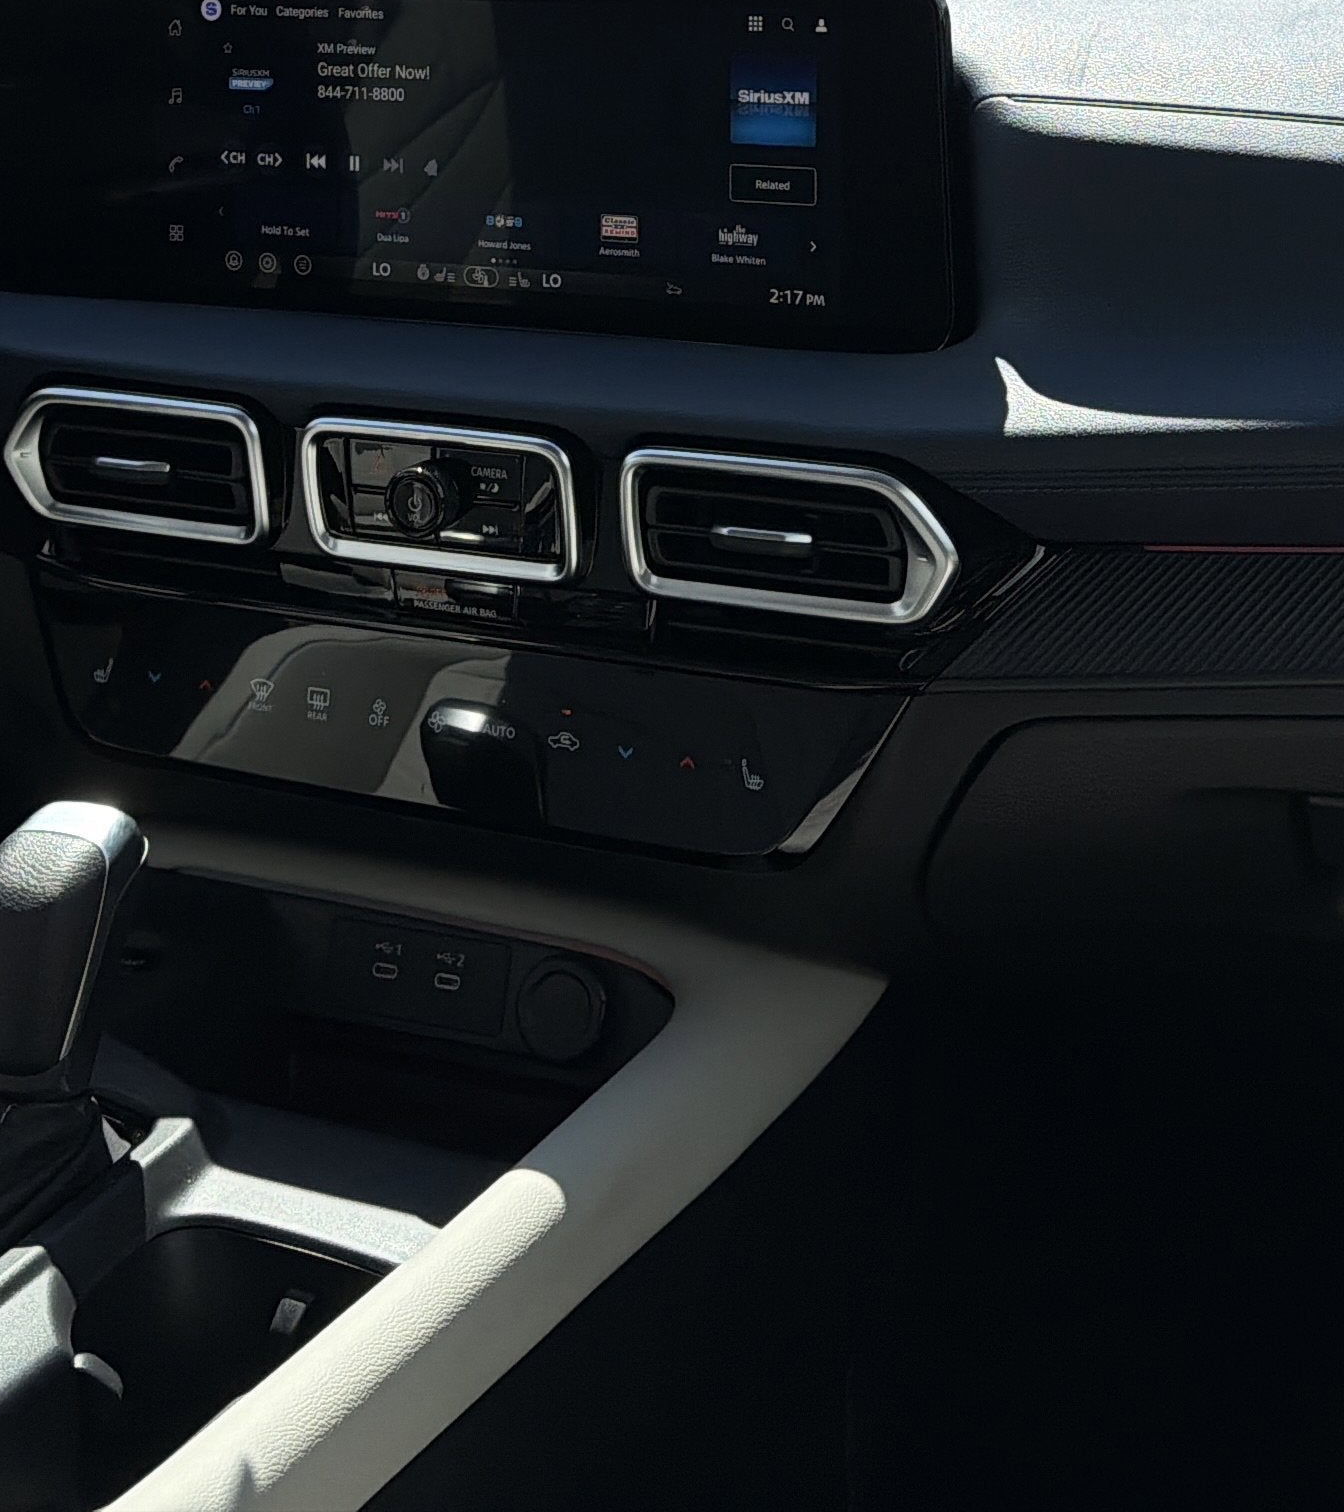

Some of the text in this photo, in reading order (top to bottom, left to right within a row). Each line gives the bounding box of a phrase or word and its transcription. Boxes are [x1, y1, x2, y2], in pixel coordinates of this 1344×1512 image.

[230, 5, 268, 16] For You
[276, 6, 329, 20] Categories
[338, 7, 384, 20] Favorites
[317, 42, 376, 55] XM Preview
[317, 62, 431, 80] Great Offer Now!
[317, 85, 405, 102] 844-711-8800
[737, 89, 810, 105] SiriusXM
[230, 152, 246, 165] CH
[257, 153, 273, 166] CH
[755, 179, 790, 191] Related
[261, 225, 310, 238] Hold To Set
[377, 232, 392, 243] Dua
[718, 228, 759, 247] highway
[478, 239, 532, 251] Howard Jones
[599, 247, 640, 258] Aerosmith
[711, 253, 767, 266] Blake Whiten
[372, 262, 391, 277] LO
[542, 272, 562, 289] LO
[769, 288, 826, 307] 2:17 PM
[470, 466, 508, 480] CAMERA
[413, 599, 497, 618] PASSENGER AIR BAG
[307, 710, 328, 721] REAR
[368, 713, 390, 728] OFF
[484, 723, 516, 738] AUTO
